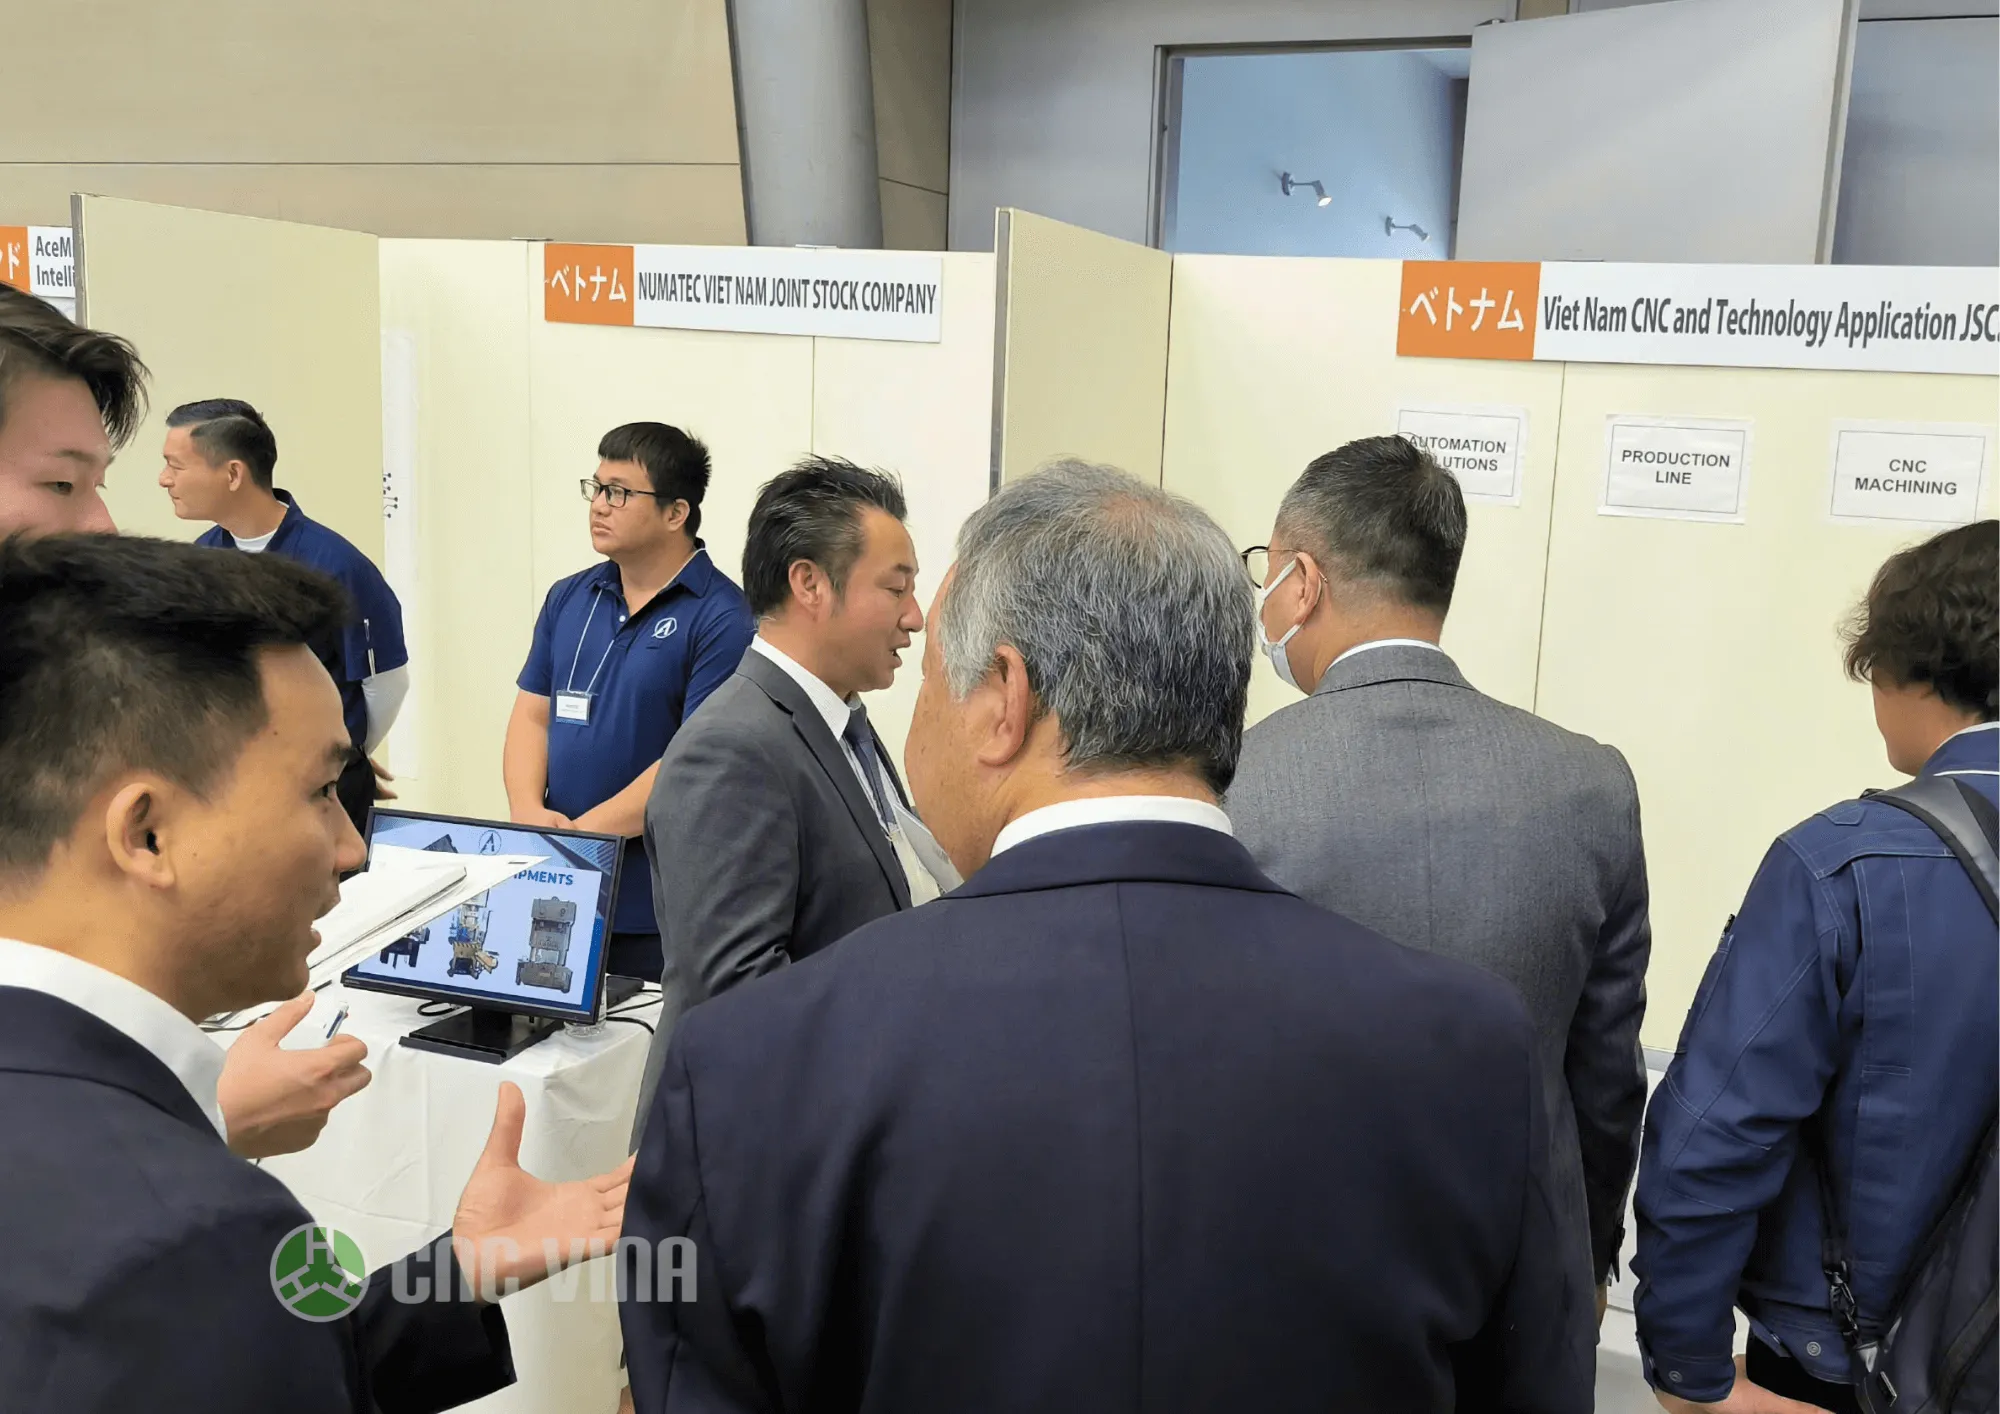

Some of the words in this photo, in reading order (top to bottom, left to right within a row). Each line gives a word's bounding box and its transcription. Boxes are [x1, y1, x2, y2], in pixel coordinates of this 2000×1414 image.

[550, 264, 627, 303] ベトナム
[638, 271, 701, 303] NUMATEC
[703, 274, 732, 305] VIET
[734, 276, 768, 307] NAM
[769, 278, 810, 309] JOINT
[812, 279, 860, 312] STOCK
[861, 281, 937, 315] COMPANY
[1409, 286, 1525, 333] ベトナム
[1543, 295, 1580, 332] Viet
[1583, 297, 1627, 333] Nam
[1630, 297, 1671, 335] CNC
[1673, 298, 1712, 336] and
[1715, 298, 1832, 348] Technology
[1834, 300, 1956, 348] Application
[1409, 436, 1507, 454] AUTOMATION
[1621, 448, 1731, 468] PRODUCTION
[1889, 459, 1927, 474] CNC
[1655, 470, 1692, 486] LINE
[1854, 477, 1957, 495] MACHINING
